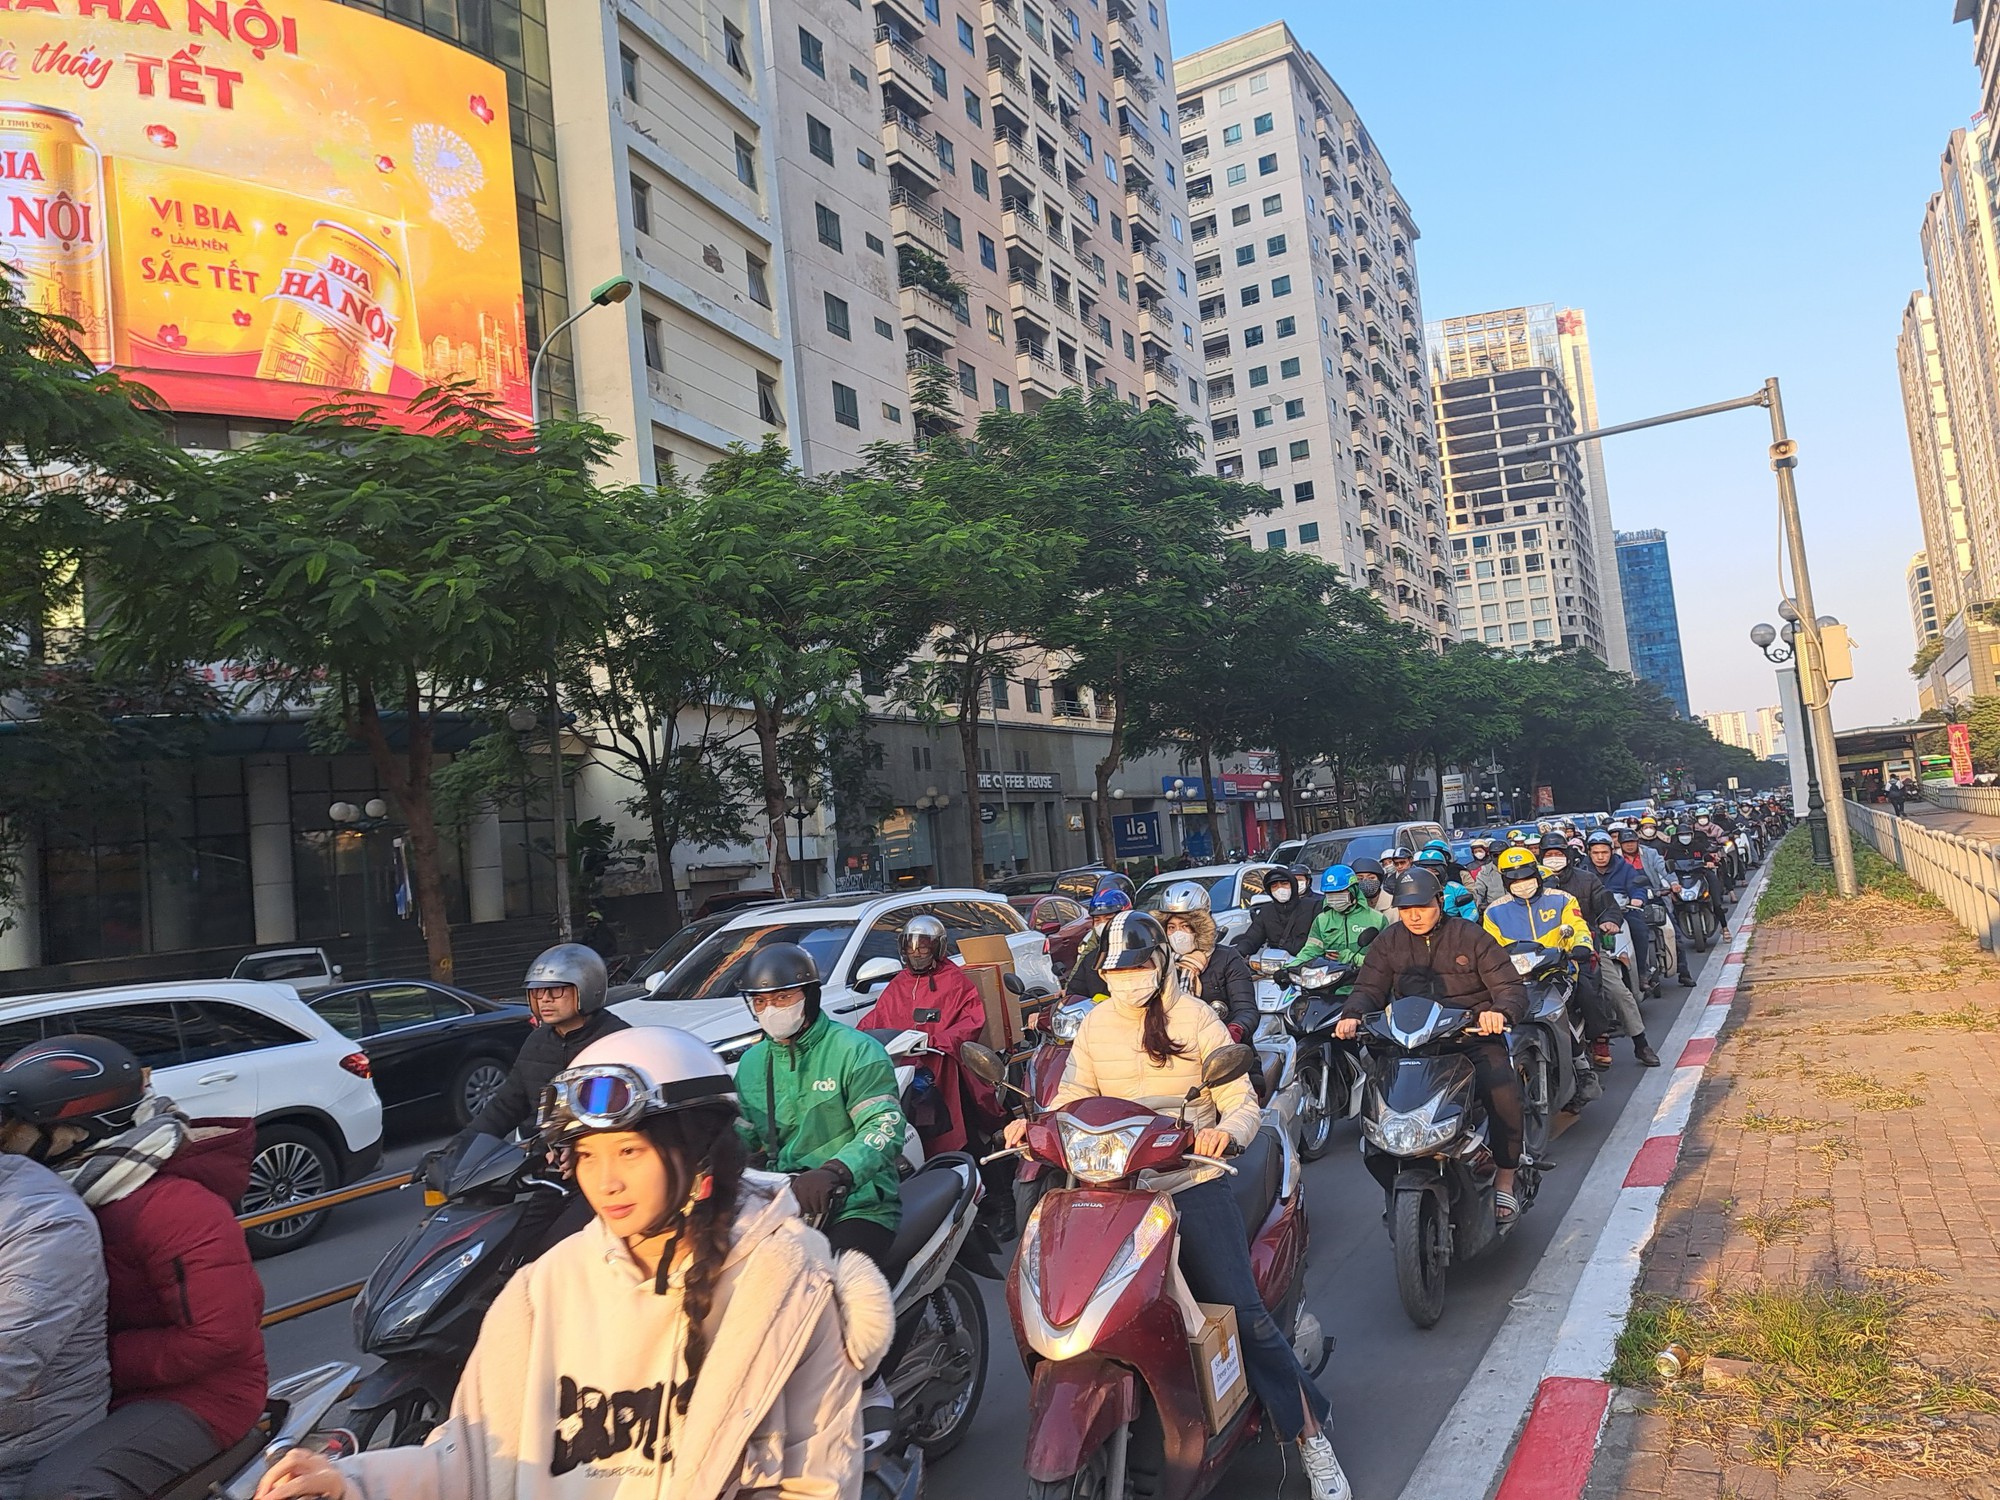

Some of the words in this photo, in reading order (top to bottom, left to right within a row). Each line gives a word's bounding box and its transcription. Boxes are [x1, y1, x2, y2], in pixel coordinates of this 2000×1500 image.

[187, 0, 298, 60] NỘI
[32, 41, 113, 89] thấy
[125, 44, 244, 110] TẾT
[8, 191, 93, 251] NỘI
[149, 197, 182, 228] VỊ
[193, 204, 242, 233] BIA
[170, 233, 198, 248] LÀM
[201, 239, 228, 252] NÊN
[141, 250, 199, 286] SẮC
[207, 260, 260, 294] TẾT
[327, 255, 371, 294] BIA
[280, 271, 333, 308] HÀ
[338, 289, 395, 351] NỘI
[1027, 775, 1053, 789] HOUSE
[1539, 908, 1557, 922] be
